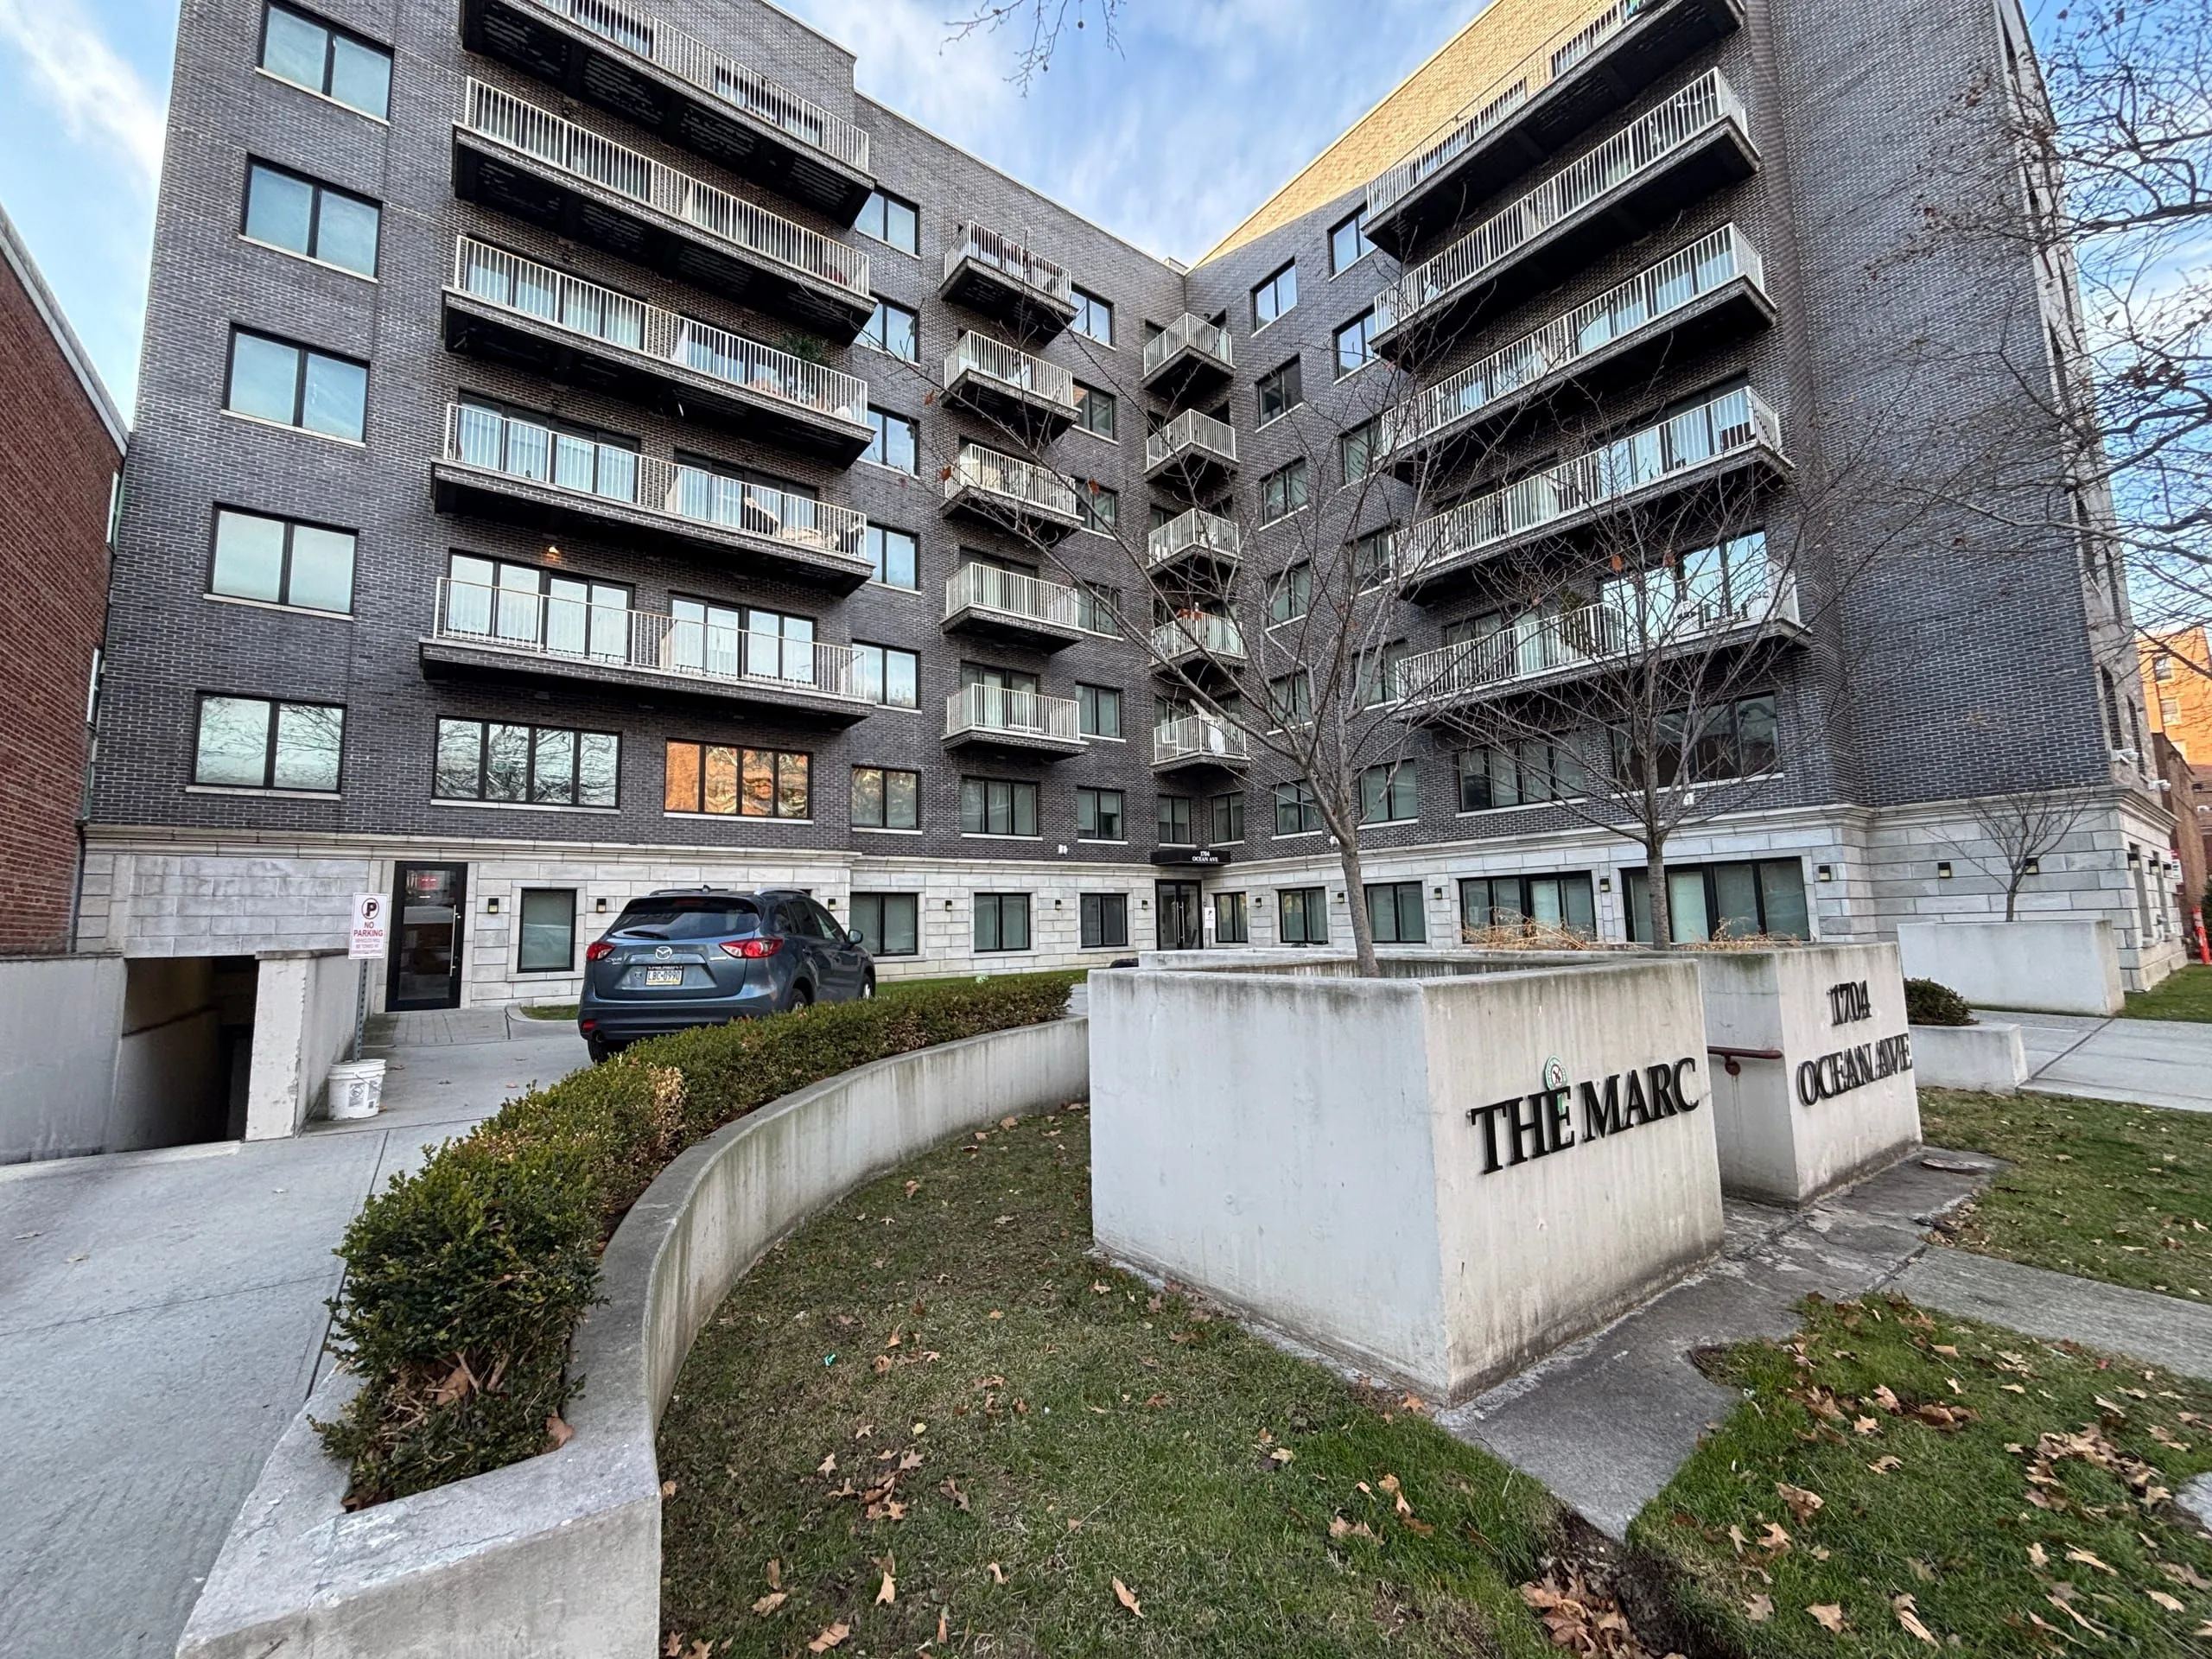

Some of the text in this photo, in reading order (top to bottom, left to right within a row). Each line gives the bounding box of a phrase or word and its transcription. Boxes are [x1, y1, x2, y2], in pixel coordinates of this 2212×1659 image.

[353, 929, 383, 938] PARKING
[1827, 980, 1872, 1026] 1704
[1796, 1033, 1912, 1106] OCEAN AVE
[1470, 1057, 1700, 1175] THE MARC
